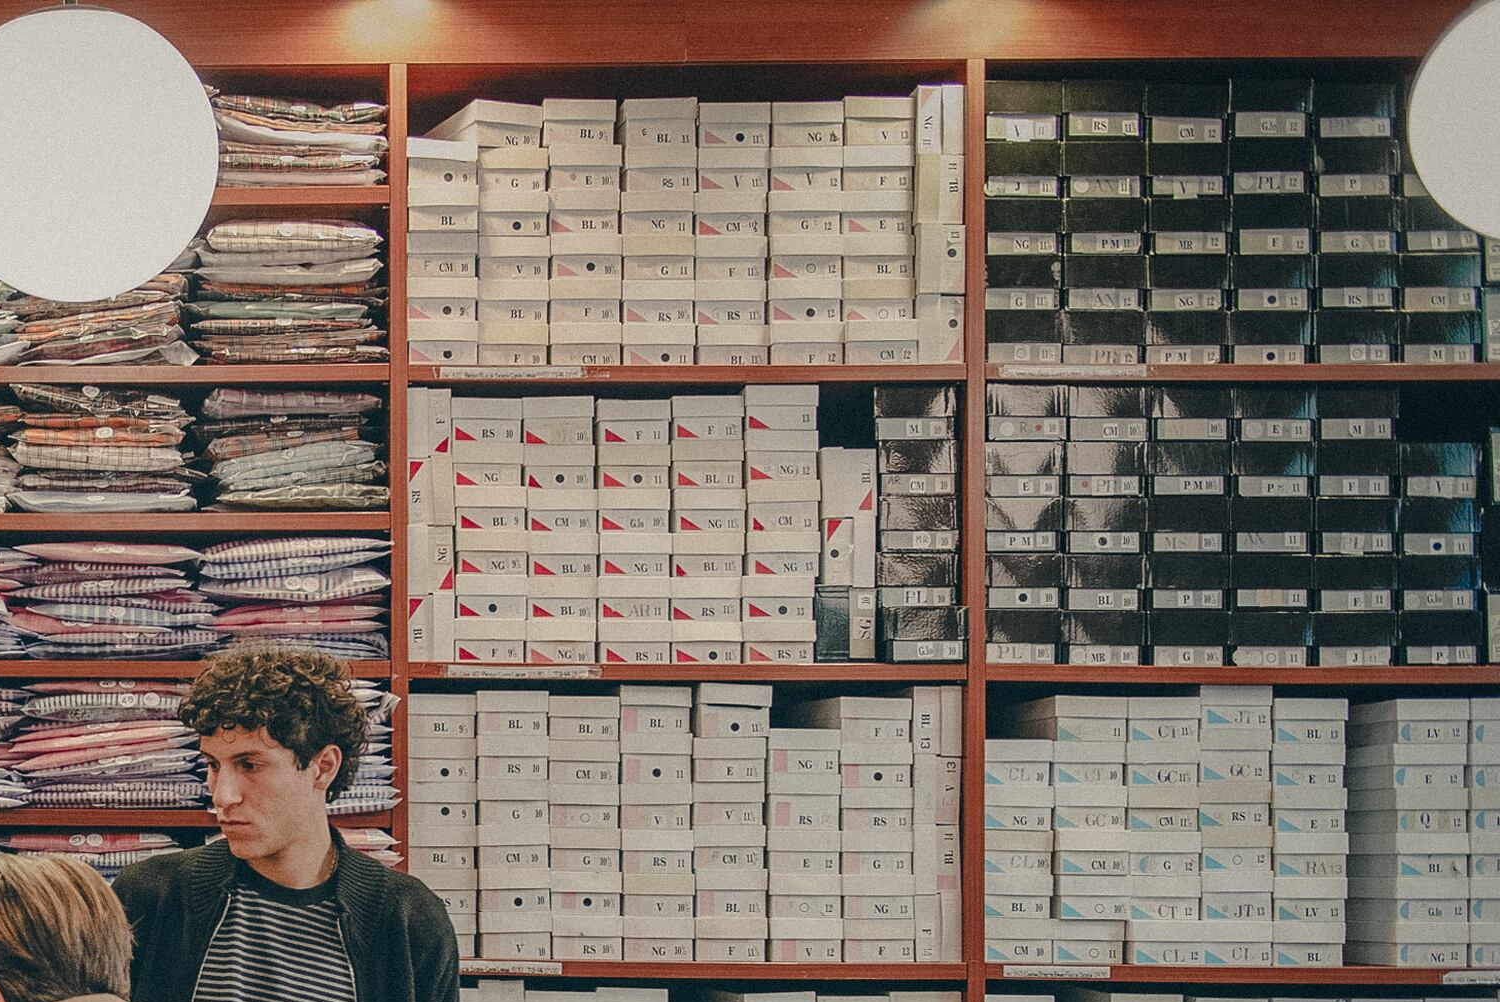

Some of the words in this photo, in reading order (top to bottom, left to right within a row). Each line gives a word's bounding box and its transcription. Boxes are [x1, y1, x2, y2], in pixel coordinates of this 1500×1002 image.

[656, 133, 672, 143] BL
[441, 215, 456, 226] BL
[650, 219, 666, 229] NG
[725, 221, 741, 232] CM
[438, 261, 454, 273] CM
[877, 264, 892, 274] BL
[510, 309, 523, 319] BL
[658, 312, 672, 322] RS
[730, 355, 743, 365] BL
[481, 428, 496, 439] RS
[484, 472, 499, 482] NG
[492, 516, 507, 527] BL
[561, 563, 577, 574] BL
[635, 651, 649, 661] RS
[777, 649, 792, 659] RS
[508, 719, 523, 729] BL
[649, 718, 664, 728] BL
[1307, 729, 1321, 739] BL
[507, 763, 521, 774] RS
[798, 759, 813, 770] NG
[873, 816, 887, 827] RS
[1013, 815, 1028, 826] NG
[1231, 811, 1246, 822] RS
[432, 853, 447, 863] BL
[505, 852, 521, 864] CM
[652, 857, 667, 867] RS
[1091, 860, 1106, 870] CM
[874, 904, 889, 914] NG
[1011, 902, 1026, 912] BL
[1305, 907, 1319, 917] LV
[652, 946, 666, 956] NG
[1307, 952, 1322, 962] BL
[1431, 952, 1445, 963] NG
